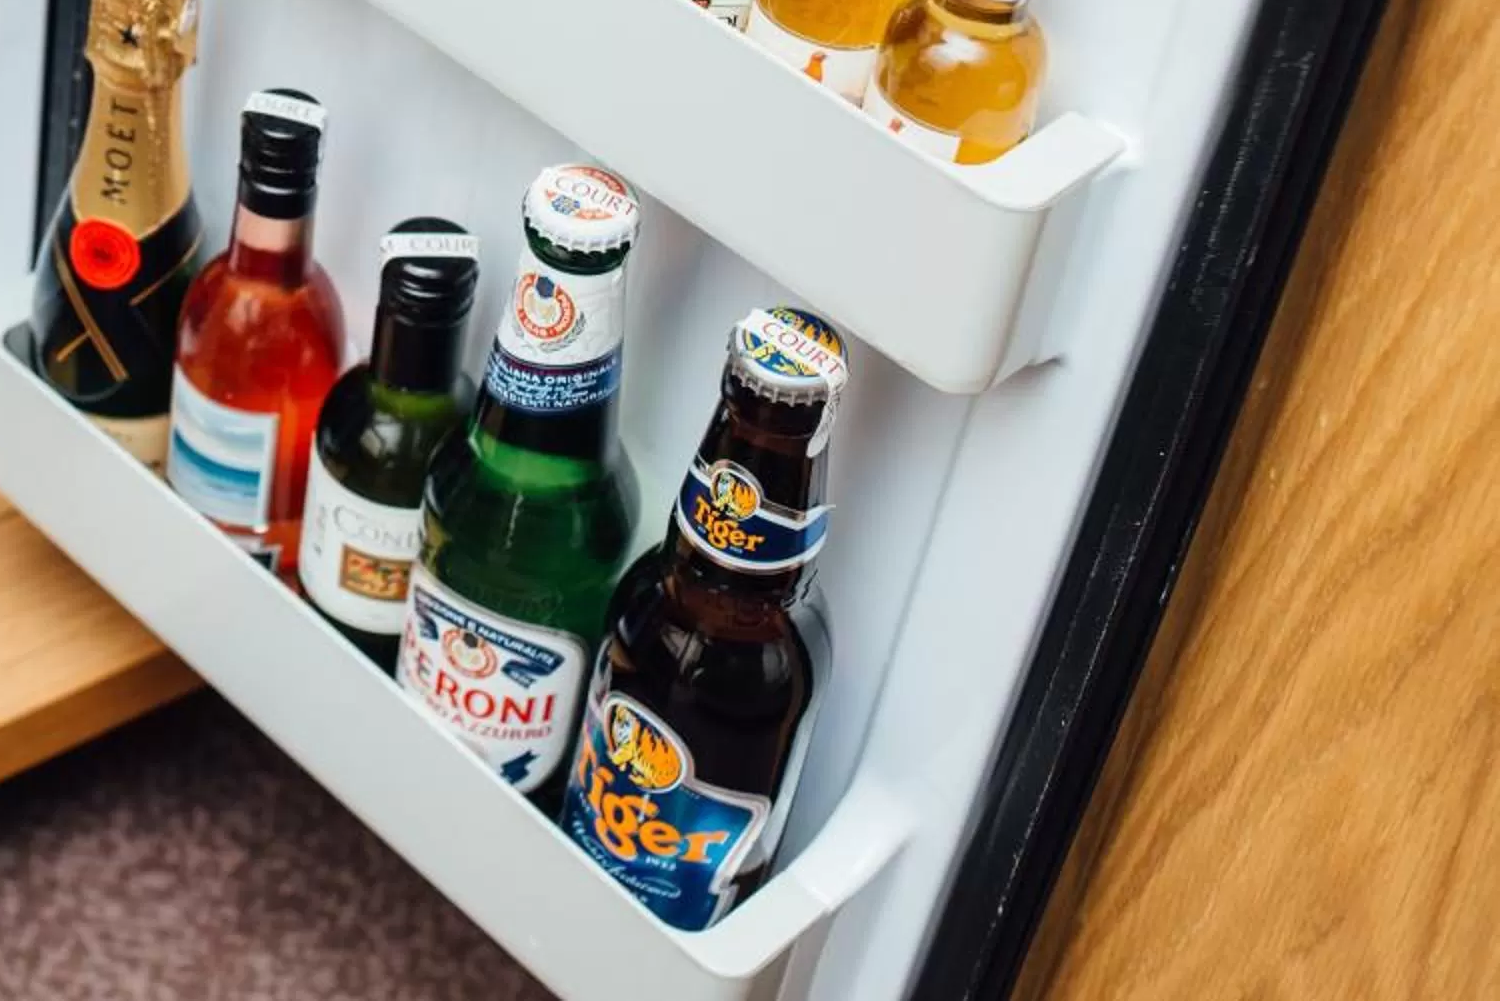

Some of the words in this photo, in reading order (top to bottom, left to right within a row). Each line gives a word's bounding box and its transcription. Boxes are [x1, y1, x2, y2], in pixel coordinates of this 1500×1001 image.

[555, 175, 638, 217] COURT
[762, 322, 842, 375] COURT
[693, 494, 765, 552] Tiger
